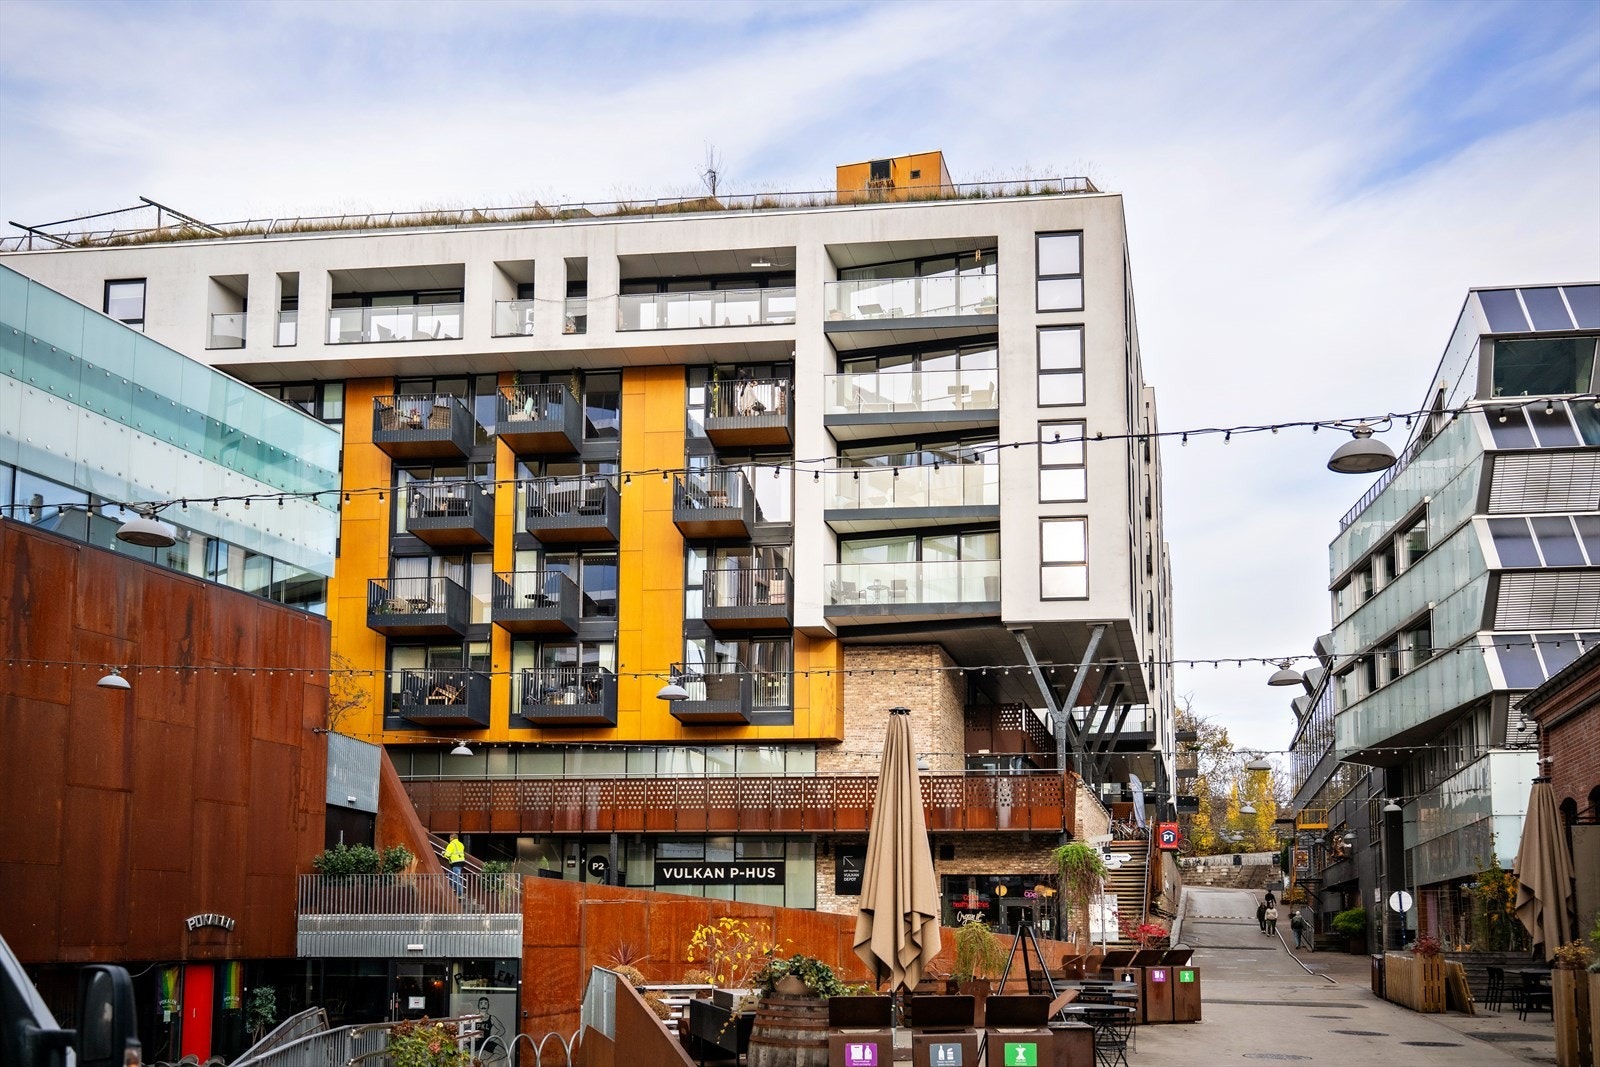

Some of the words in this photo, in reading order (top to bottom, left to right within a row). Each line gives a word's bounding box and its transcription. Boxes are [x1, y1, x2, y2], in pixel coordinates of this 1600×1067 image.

[1163, 834, 1174, 842] P1
[663, 867, 725, 879] VULKAN
[730, 867, 776, 879] P-HUS
